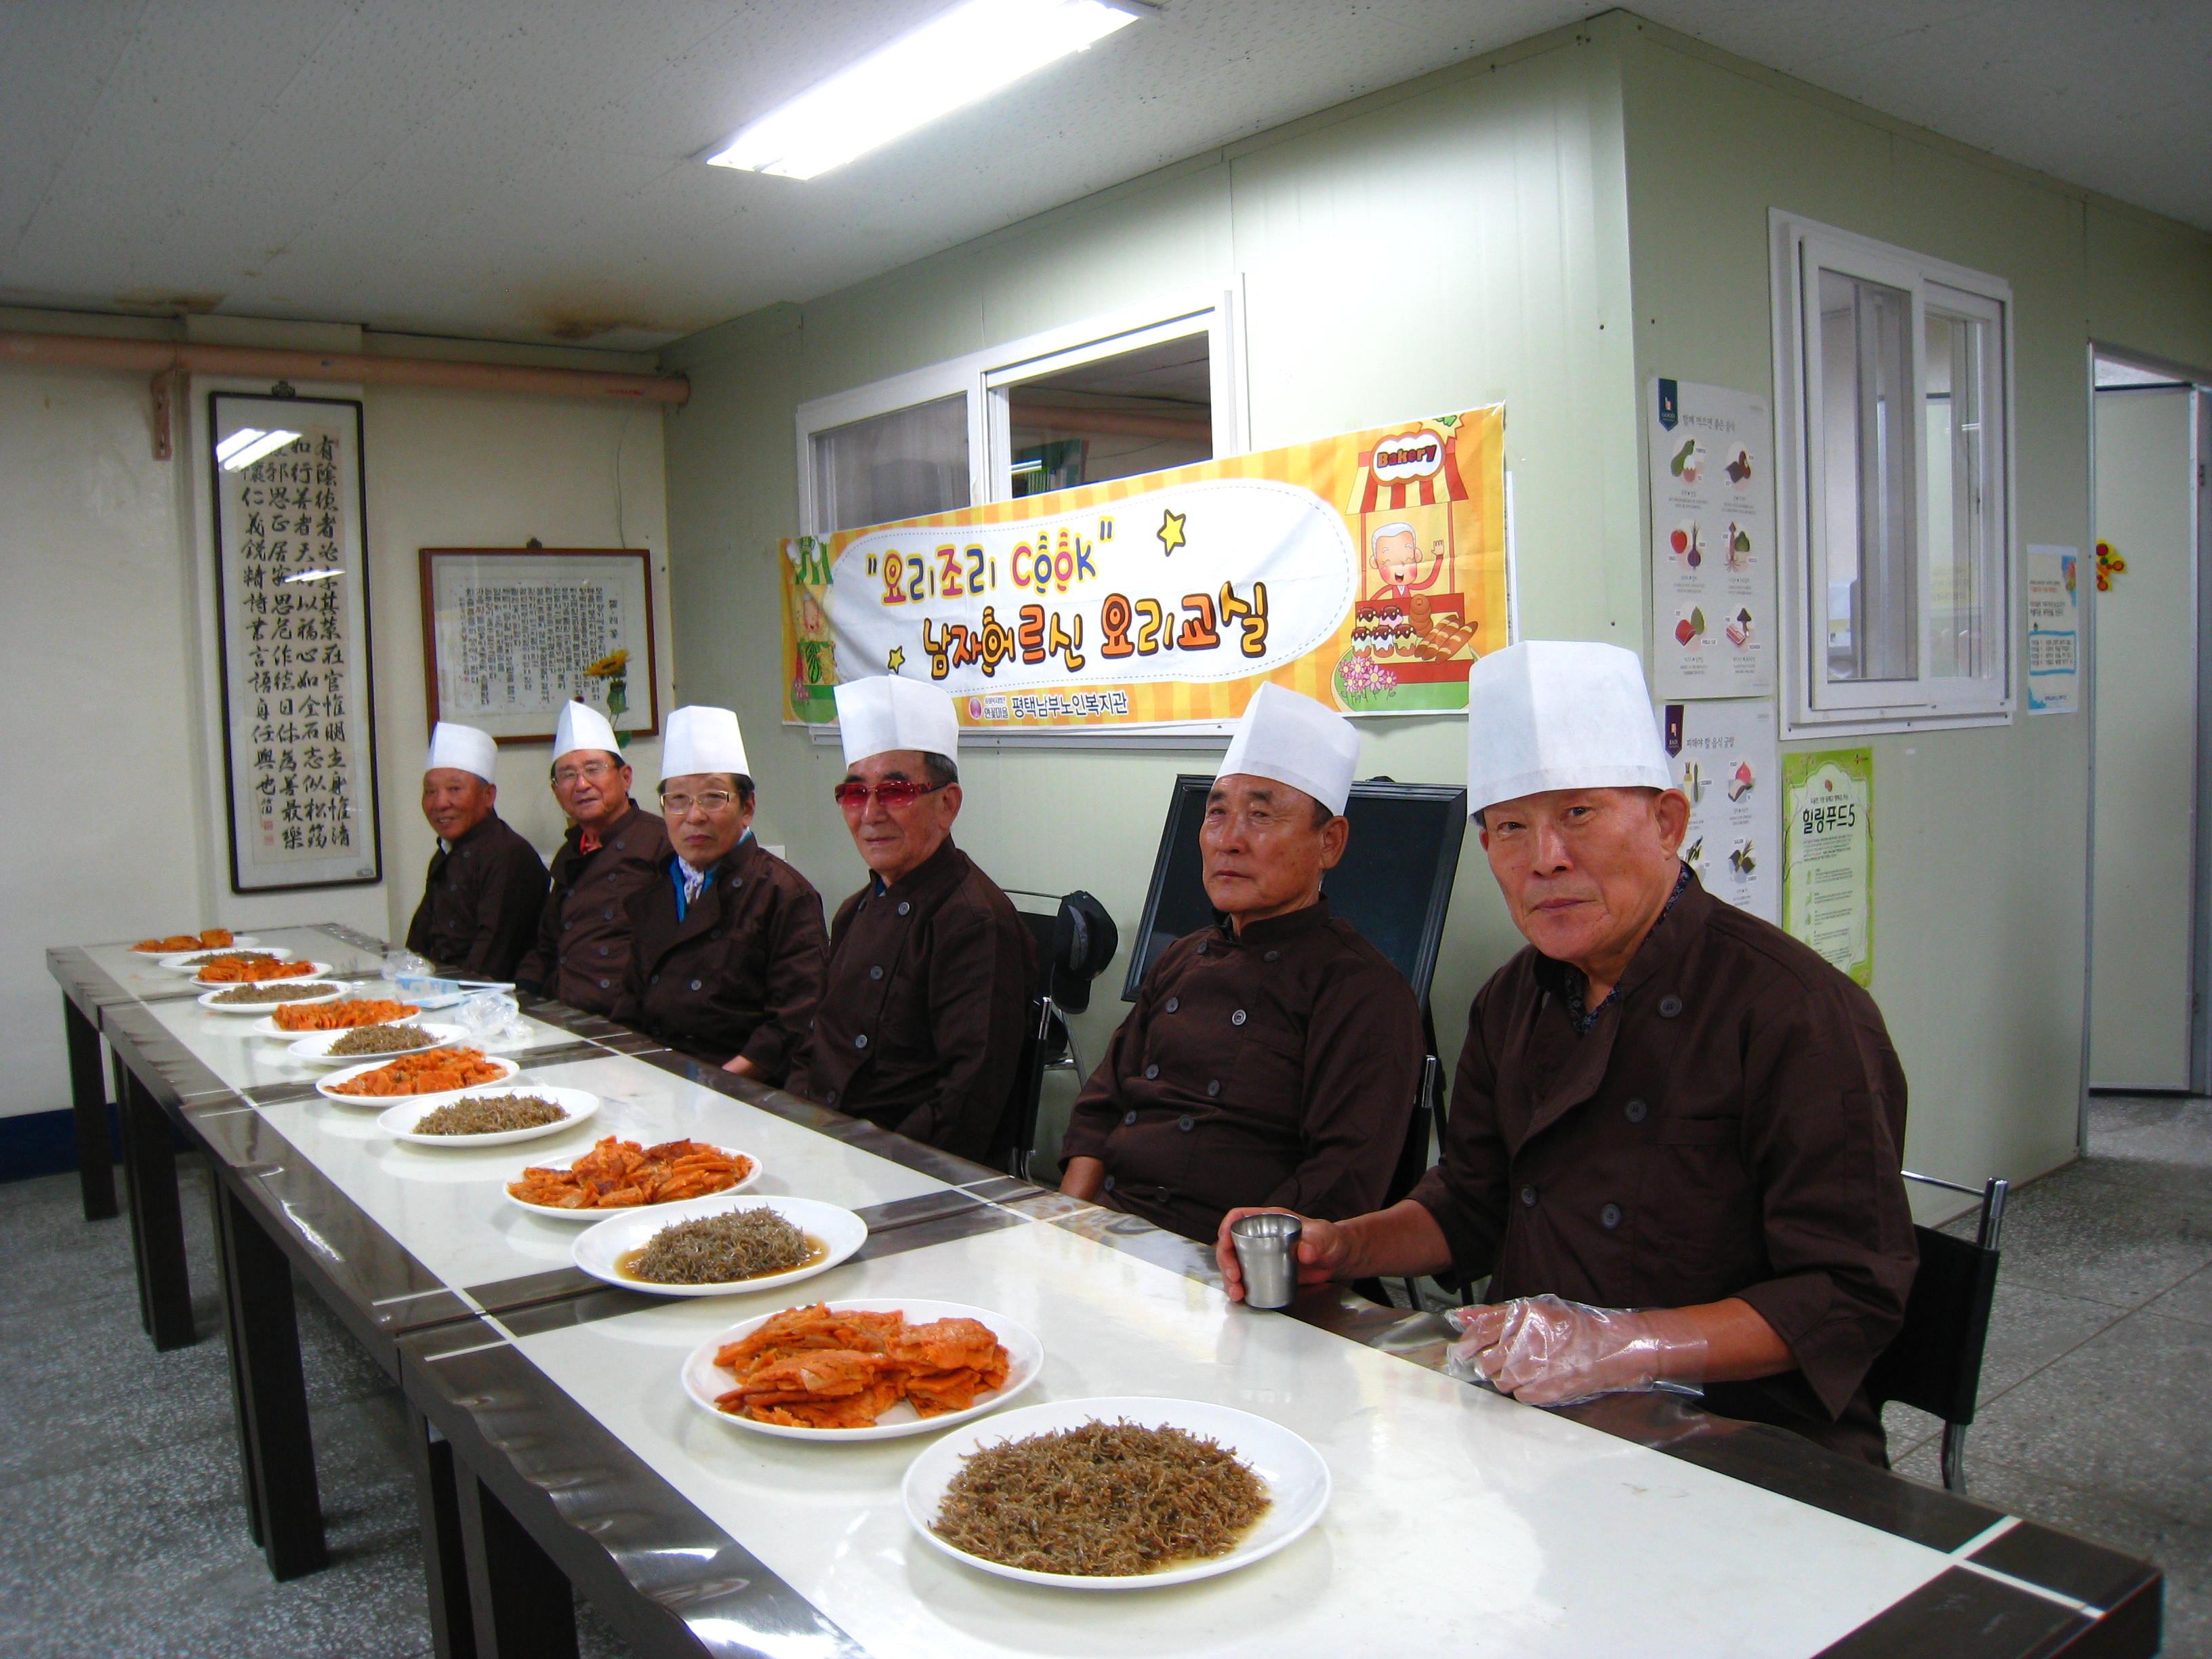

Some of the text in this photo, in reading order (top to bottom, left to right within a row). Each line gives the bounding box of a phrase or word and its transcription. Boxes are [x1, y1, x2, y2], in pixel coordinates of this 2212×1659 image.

[1696, 416, 1713, 429] 먹으면
[1376, 444, 1437, 468] Bakery
[923, 580, 1269, 680] 남자어르신 요리교실
[984, 707, 1008, 719] 연꽃마을
[1012, 691, 1128, 718] 평택남부노인복지관
[1687, 737, 1703, 748] 피해야
[1712, 737, 1723, 748] 음식
[1802, 803, 1856, 834] 힐링푸드5
